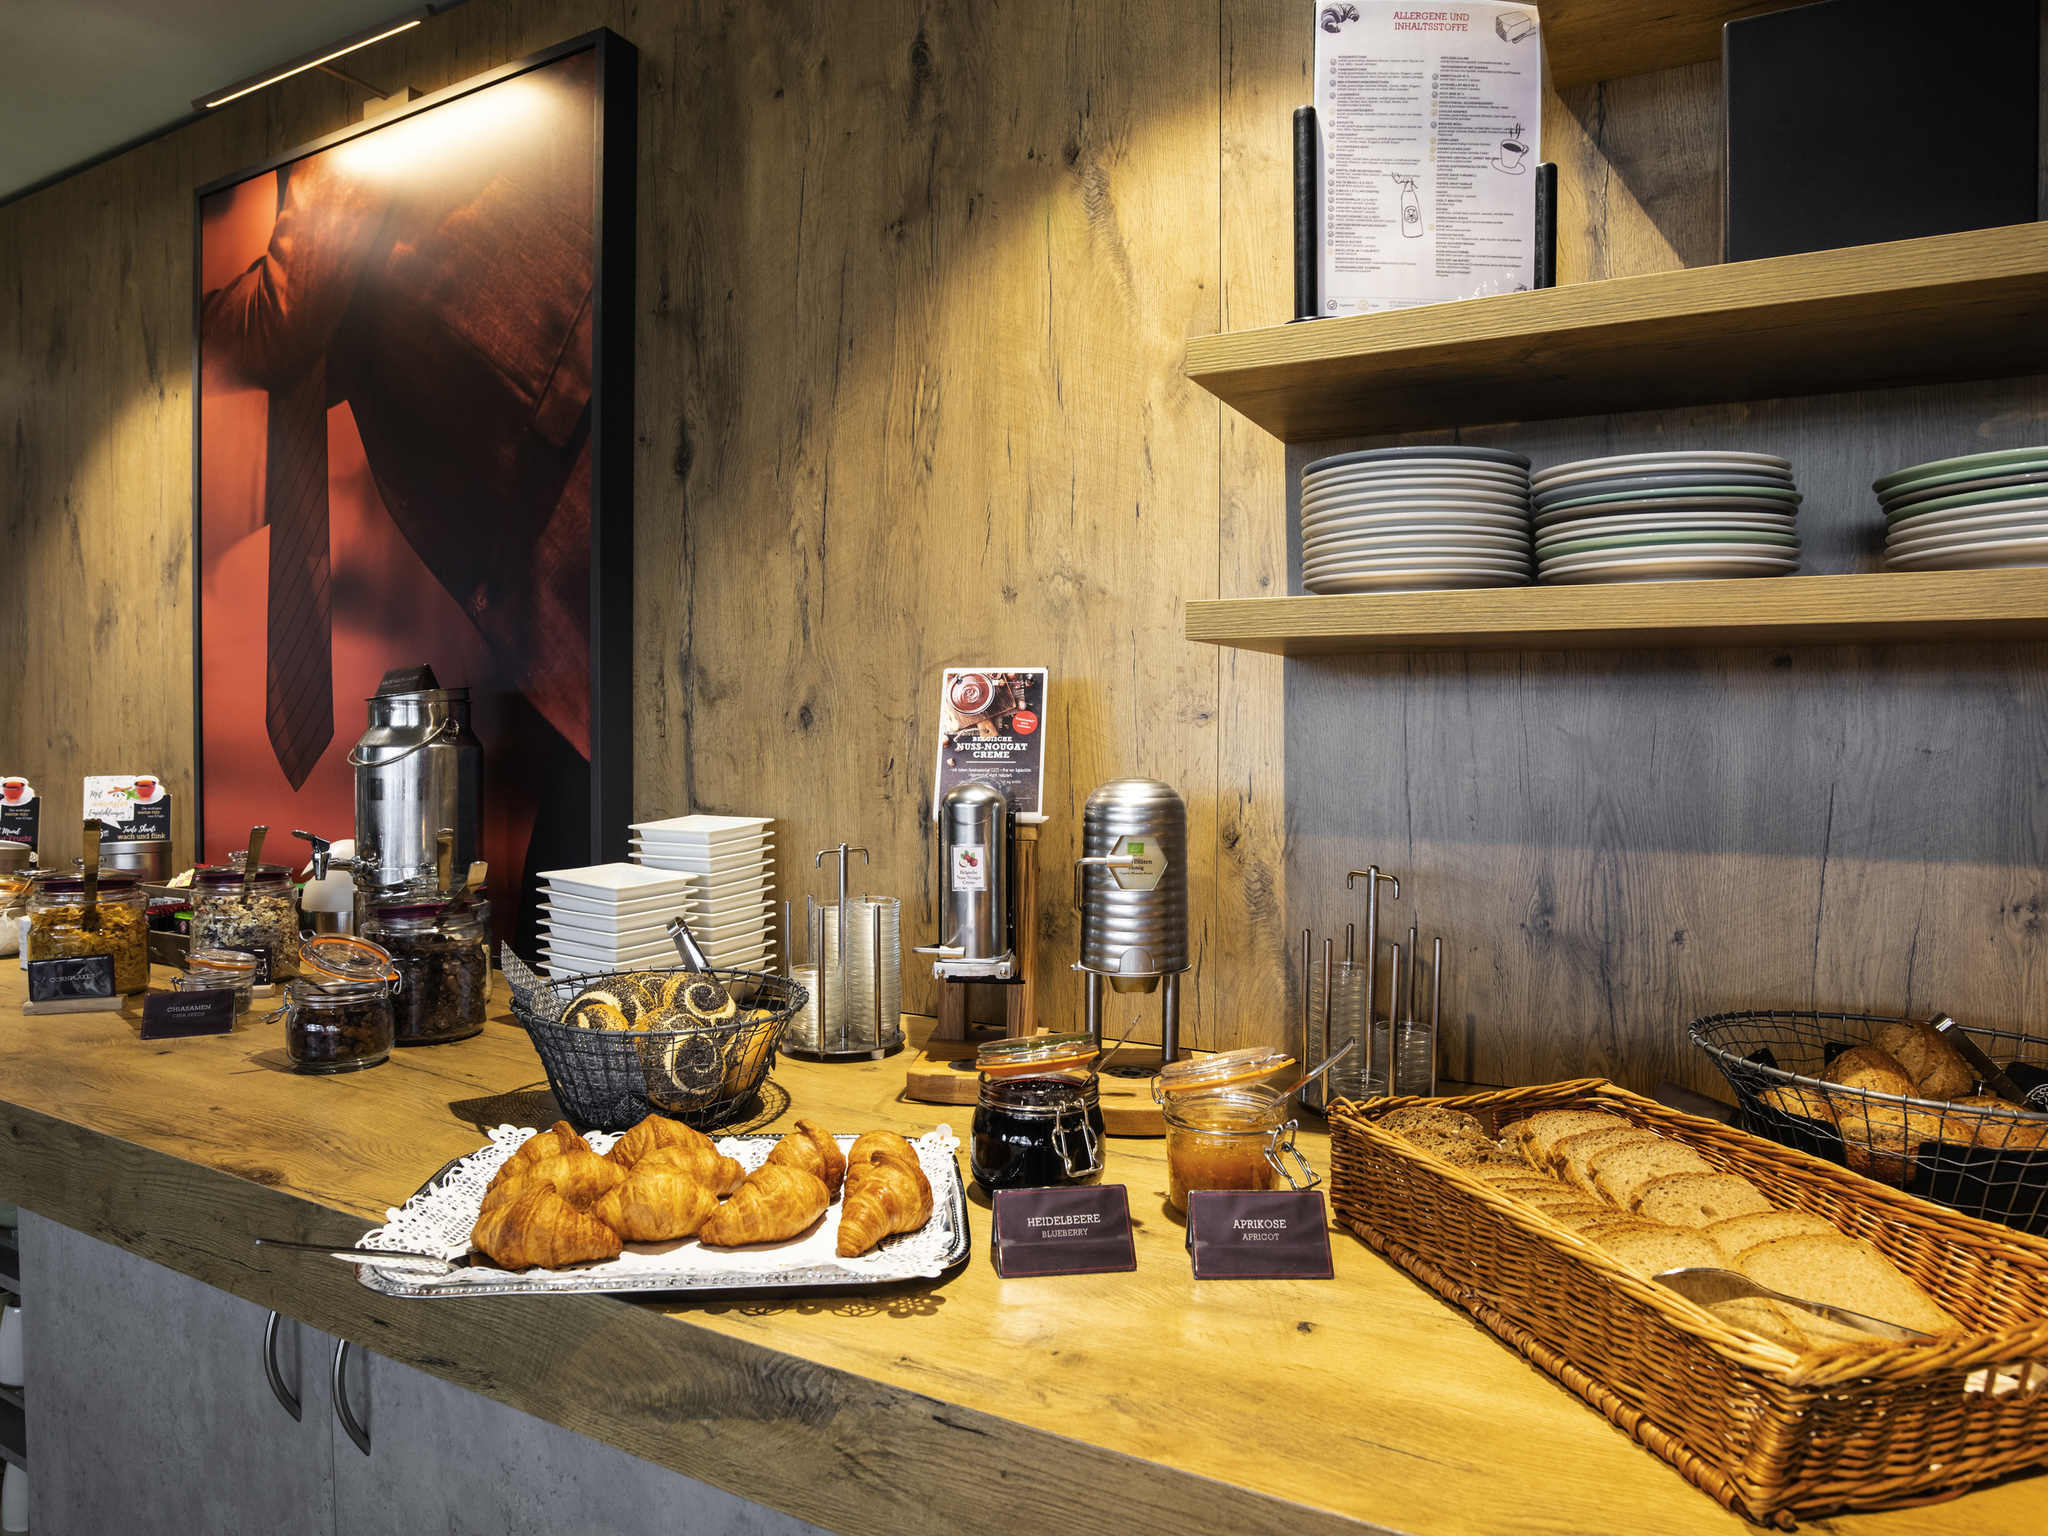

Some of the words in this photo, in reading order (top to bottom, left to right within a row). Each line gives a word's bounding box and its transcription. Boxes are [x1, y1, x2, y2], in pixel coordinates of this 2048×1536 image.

[1393, 11, 1448, 21] ALLERGENE
[1449, 12, 1470, 22] UND
[1394, 22, 1469, 32] INHALTSSTOFFE
[955, 742, 1029, 751] NUSS-NOUGAT
[973, 751, 1010, 759] CREME
[1027, 1213, 1101, 1228] HEIDELBEERE
[1232, 1218, 1287, 1230] APRIKOSE
[1041, 1227, 1089, 1239] BLUEBERRY
[1242, 1232, 1280, 1241] APRICOT
